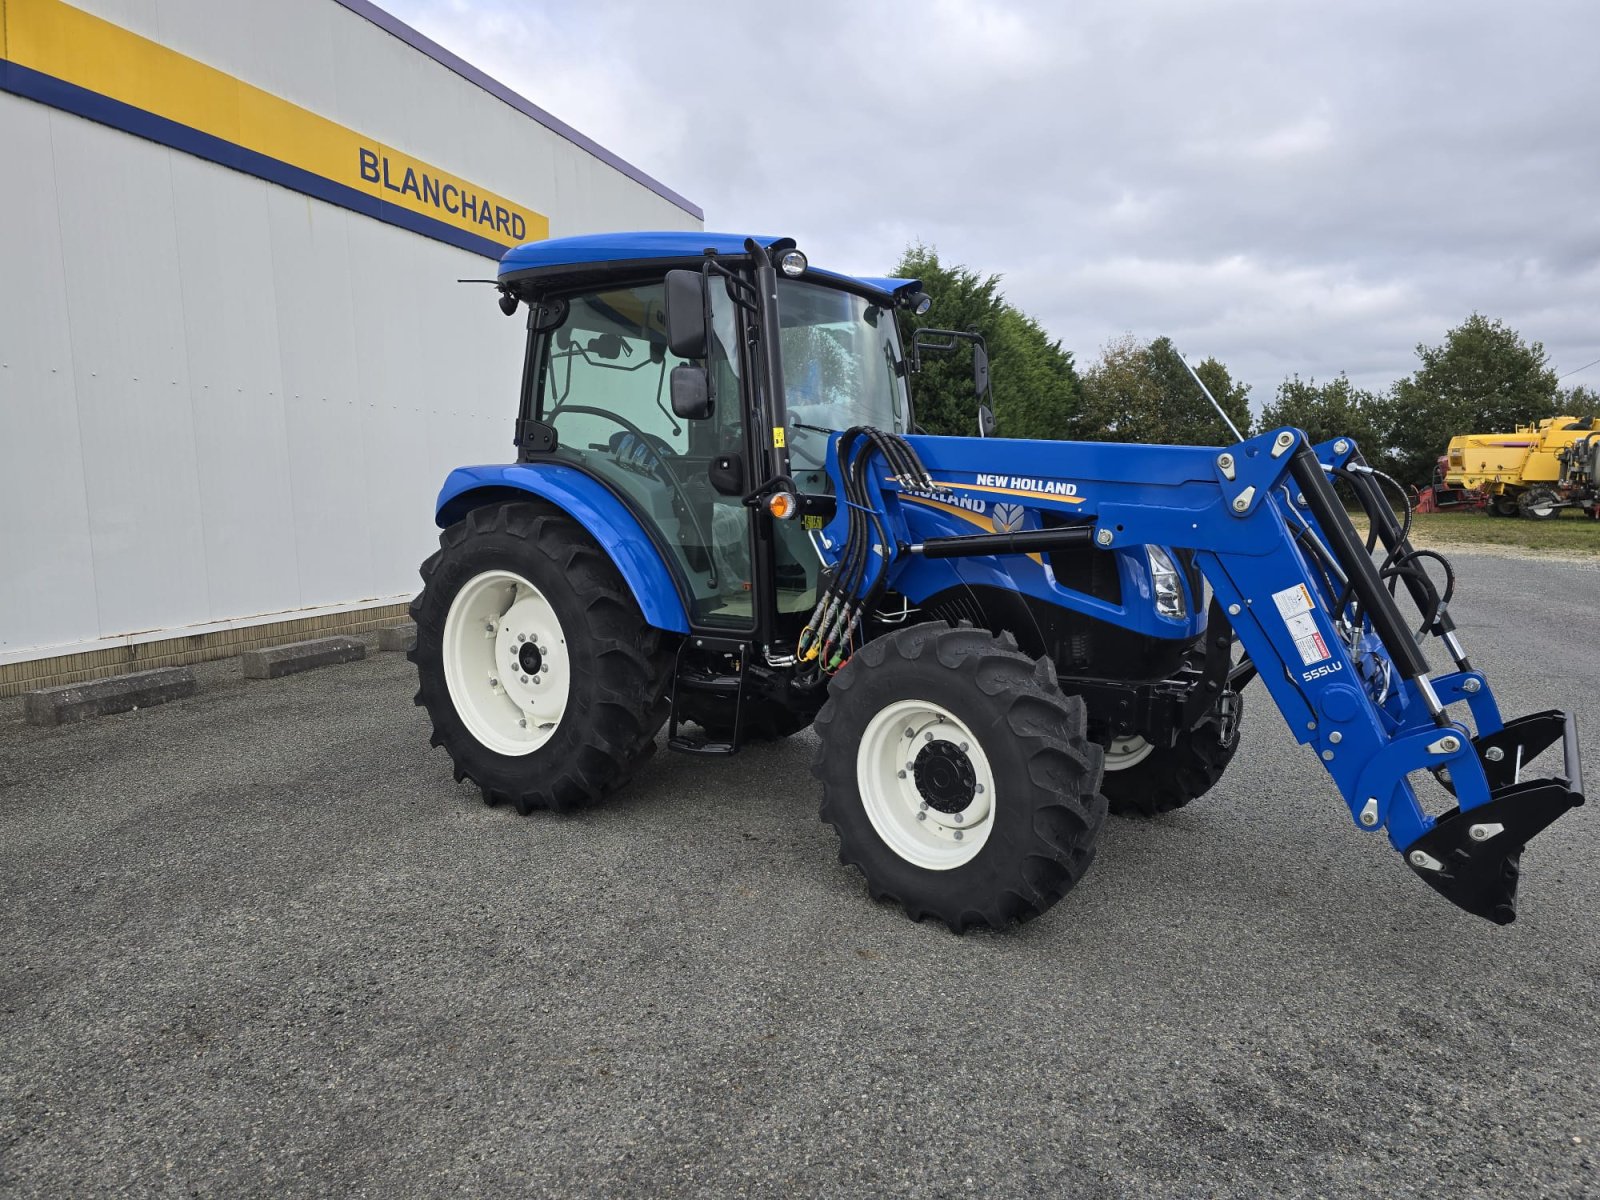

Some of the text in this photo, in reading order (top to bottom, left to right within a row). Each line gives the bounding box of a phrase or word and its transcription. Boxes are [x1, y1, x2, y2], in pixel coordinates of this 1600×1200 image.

[359, 147, 526, 240] BLANCHARD
[976, 474, 1077, 496] NEW HOLLAND
[1302, 661, 1342, 682] 555LU
